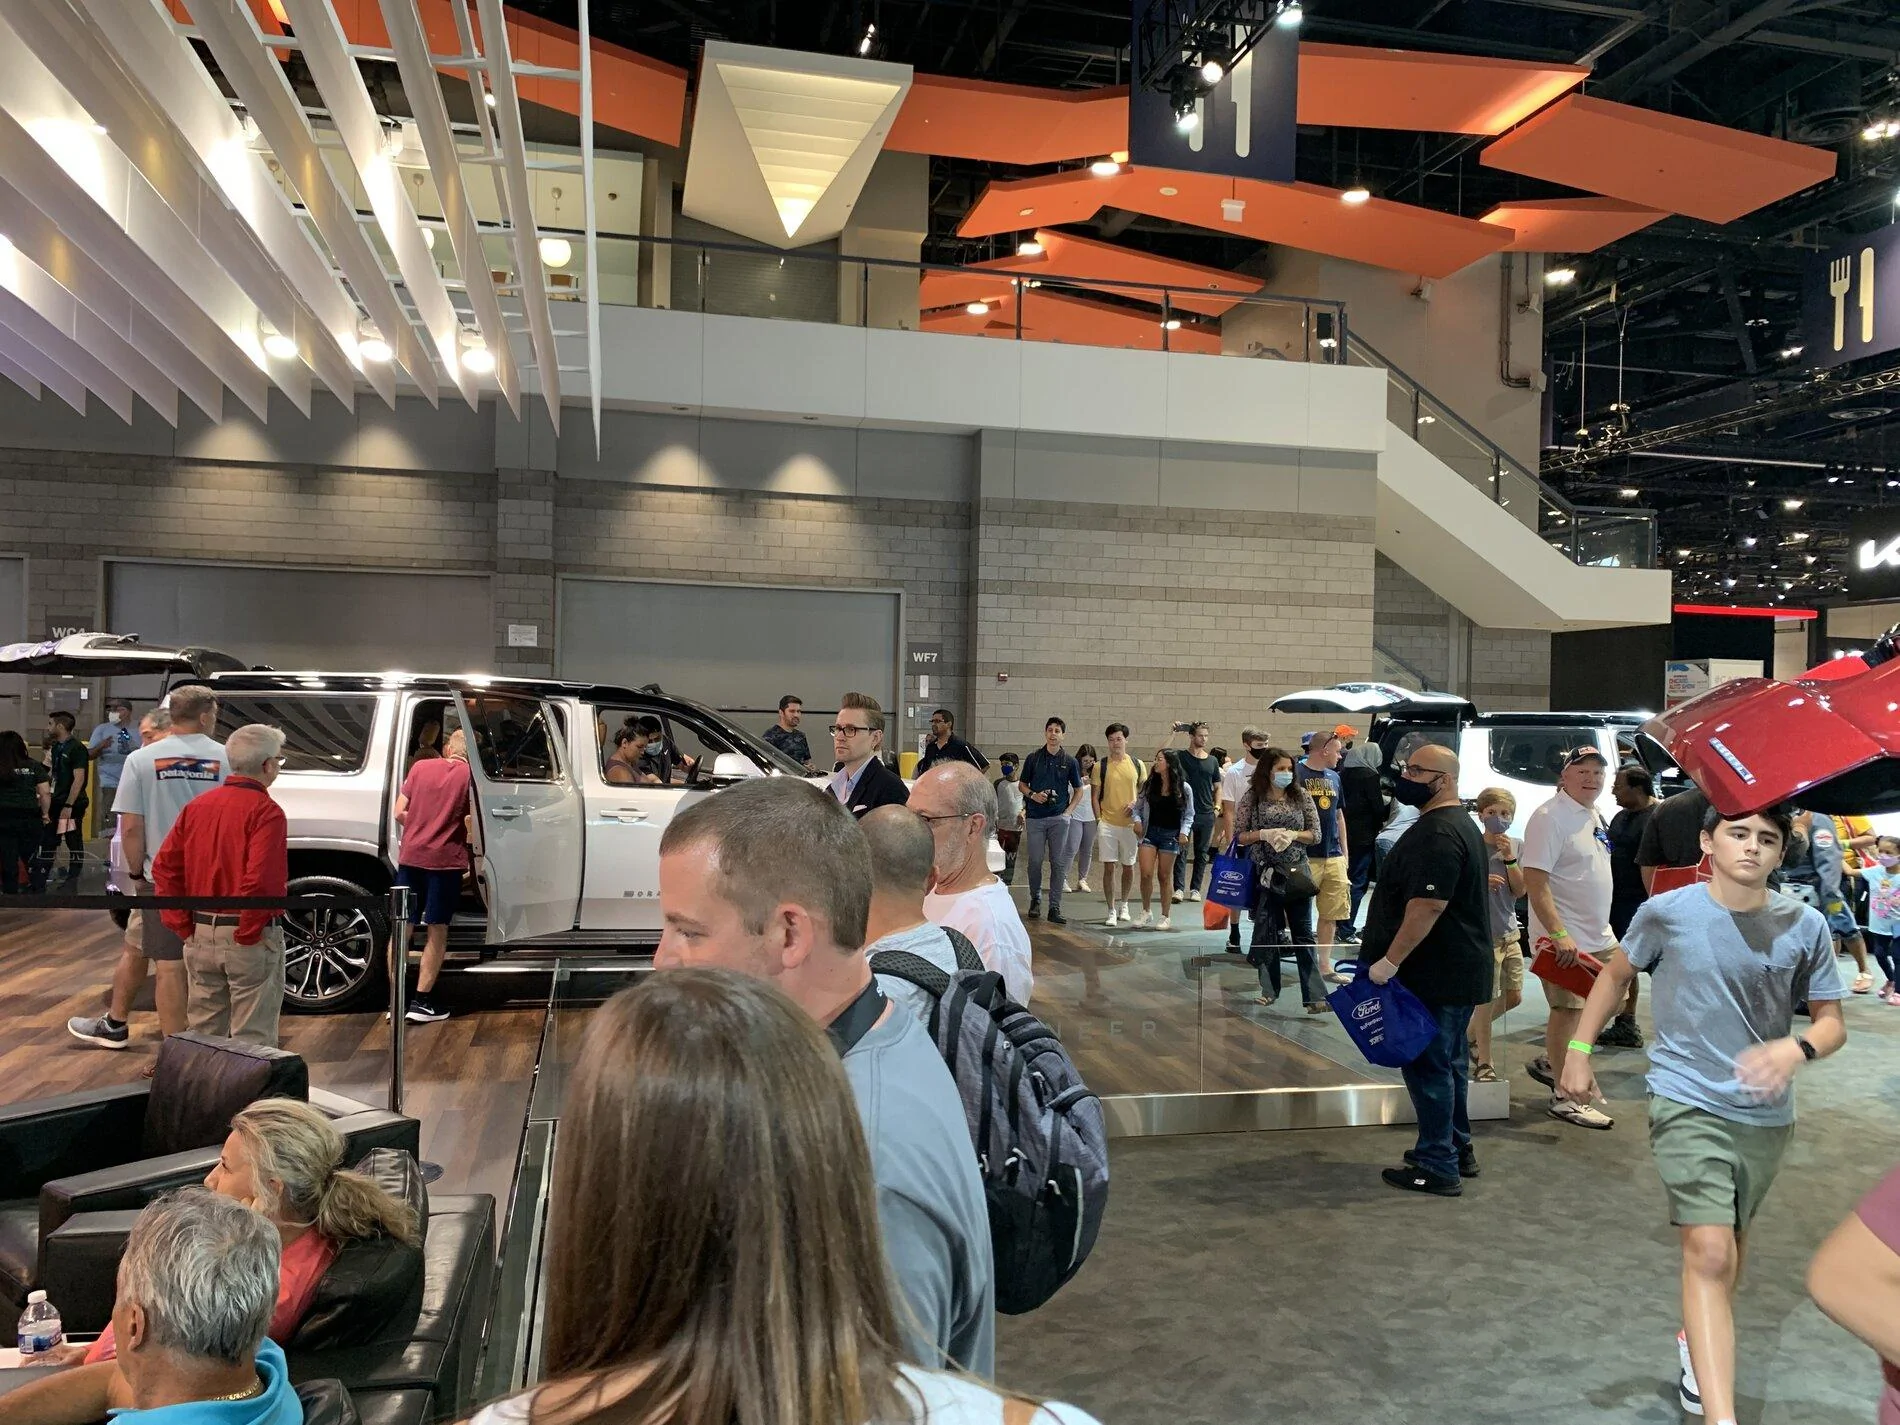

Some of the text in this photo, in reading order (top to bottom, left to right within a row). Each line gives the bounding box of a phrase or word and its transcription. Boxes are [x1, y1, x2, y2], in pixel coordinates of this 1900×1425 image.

[912, 652, 938, 663] WF7
[159, 769, 215, 780] patagonia
[1223, 871, 1241, 881] Ford
[1357, 1000, 1382, 1018] Ford
